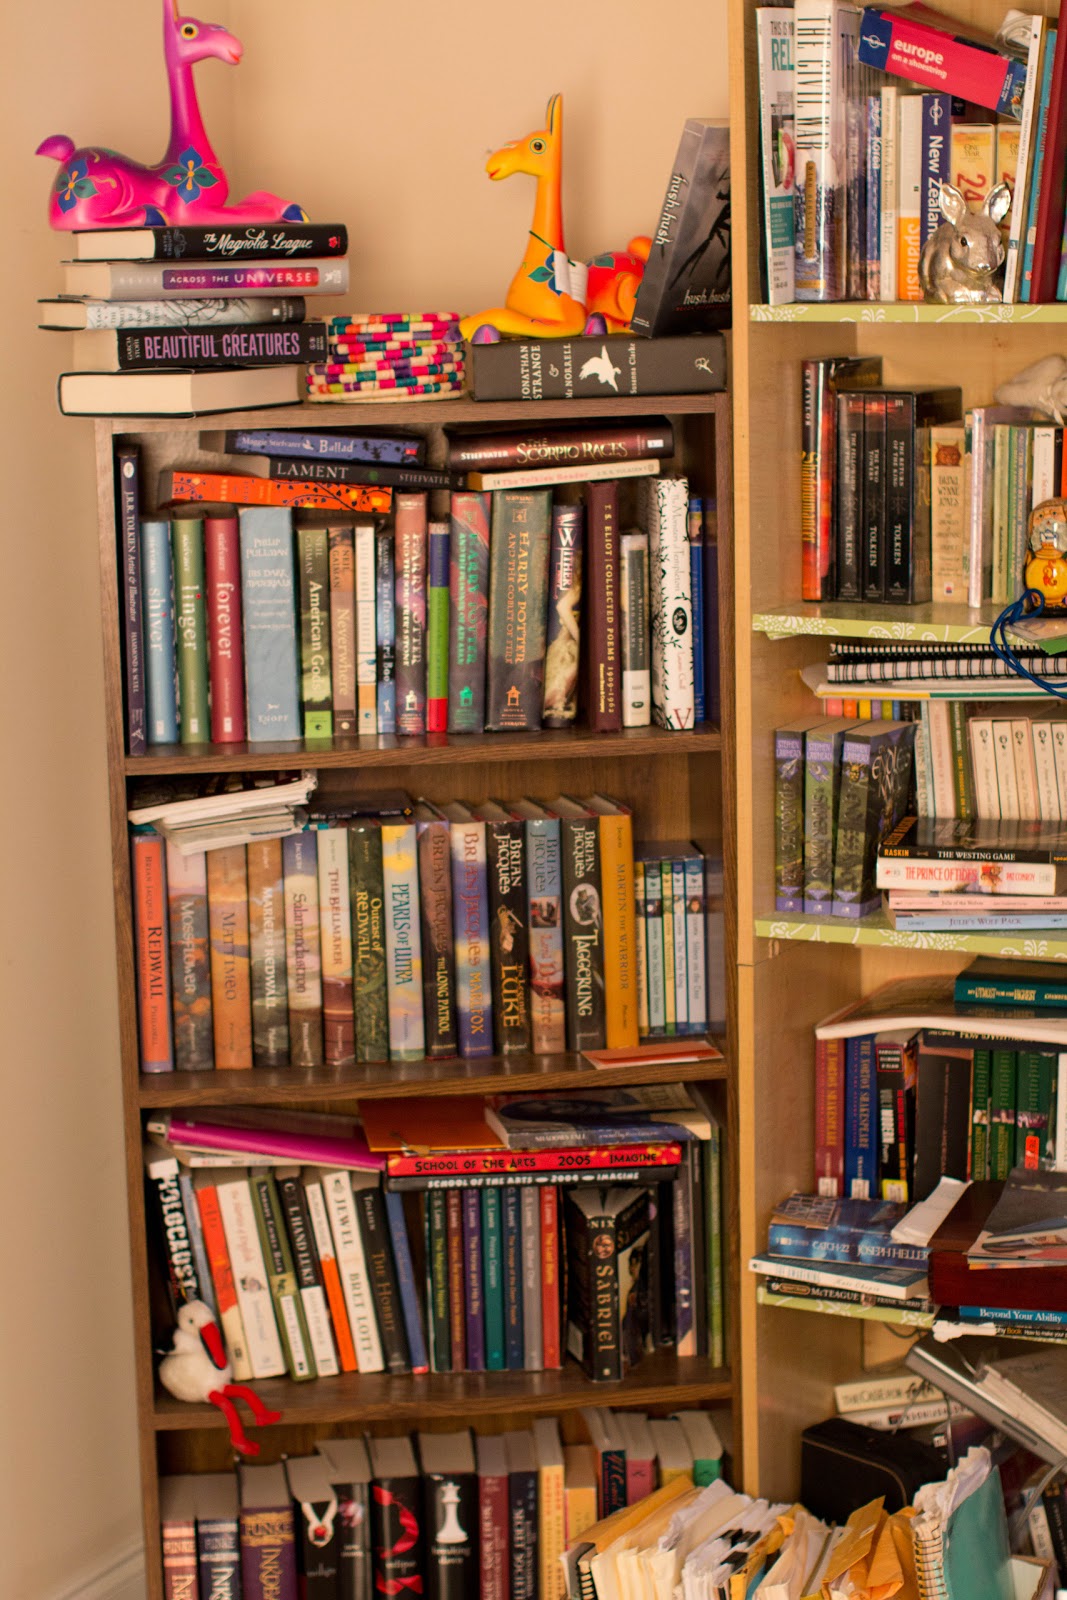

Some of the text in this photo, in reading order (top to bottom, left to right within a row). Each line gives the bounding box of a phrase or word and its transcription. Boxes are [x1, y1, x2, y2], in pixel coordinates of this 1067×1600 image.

[892, 53, 902, 61] on
[909, 58, 947, 79] shoestring
[894, 39, 943, 65] europe
[797, 16, 831, 151] THE CIVIL WAR
[871, 136, 880, 170] Korea
[928, 135, 944, 174] New
[203, 229, 314, 256] The Magnolia League
[170, 272, 312, 284] ACROSS THE UNIVERSE
[144, 332, 300, 360] BEAUTIFUL CREATURES
[564, 343, 572, 381] NORRELL
[521, 345, 531, 400] JONATHAN
[533, 345, 543, 400] STRANGE
[241, 437, 269, 448] Maggie
[319, 439, 354, 453] Ballad
[516, 441, 628, 463] SCORPIO RACES
[527, 437, 548, 448] THE
[277, 462, 450, 486] LAMENT STIEFVATER
[801, 451, 821, 544] Shadowmancer
[125, 491, 138, 621] J.R.R. TOLKIEN Artist Illustrator
[304, 535, 314, 575] GAIMAN
[331, 549, 342, 588] GAIMAN
[341, 549, 350, 572] NEIL
[507, 532, 516, 557] AND
[671, 505, 684, 591] Monsters Templeton
[844, 525, 854, 565] TOLKIEN
[869, 526, 878, 567] TOLKIEN
[893, 524, 902, 565] TOLKIEN
[507, 560, 516, 582] THE
[147, 587, 167, 652] shiver
[178, 584, 201, 650] linger
[216, 581, 235, 659] forever
[515, 531, 530, 665] HARRY POTTER
[604, 525, 615, 713] ELIOT COLLECTED POEMS 1909-1962
[308, 580, 325, 691] American Gods
[337, 608, 352, 696] Neverwhere
[411, 600, 422, 666] POTTER
[506, 623, 515, 637] OF
[144, 856, 152, 882] BRIAN
[432, 834, 447, 884] BRIAN
[493, 832, 512, 895] JACQUES
[509, 838, 523, 888] BRIAN
[530, 831, 549, 893] JACQUES
[546, 838, 559, 886] BRIAN
[570, 825, 587, 879] JACQUES
[584, 830, 596, 872] BRIAN
[884, 849, 1016, 861] RASKIN THE WESTING GAME
[917, 867, 944, 881] PRINCE
[145, 884, 154, 921] JACQUES
[328, 868, 343, 965] THE BELLMAKER
[371, 897, 382, 939] Outcast
[949, 917, 1021, 927] JULIE'S WOLF PACK
[180, 901, 197, 994] MOSSFLOWER
[262, 887, 277, 1010] MARIEL REDWALL
[292, 893, 311, 994] Salamandastron
[356, 891, 370, 963] REDWALL
[392, 883, 413, 986] PEARLS OF LUTRA
[460, 832, 485, 1035] BRIAN JACQUES MARLFOX
[616, 863, 629, 991] MARTIN WARRIOR
[148, 926, 163, 1000] REDWALL
[221, 911, 236, 1000] MATTIMEO
[572, 928, 599, 1017] TAGGERUNG
[436, 970, 449, 997] LONG
[500, 965, 519, 1028] LUKE
[437, 999, 451, 1035] PATROL
[415, 1153, 658, 1173] SCHOOL OF THE ARTS 2005 IMAGINE
[427, 1172, 640, 1189] SCHOOL OF THE ARTS IMAGINE
[158, 1172, 199, 1290] HOLOCAUST
[591, 1219, 615, 1229] NIX
[291, 1216, 316, 1285] HAND LUKE
[363, 1194, 395, 1332] TOLKIEN THE HOBBIT
[812, 1240, 929, 1261] CATCH-22 JOSEPH HELLER
[335, 1198, 374, 1352] JEWEL BRET LOTT
[810, 1287, 862, 1301] McTEAGUE
[596, 1264, 617, 1353] SABRIEL
[980, 1308, 1062, 1323] Beyond Your Ability
